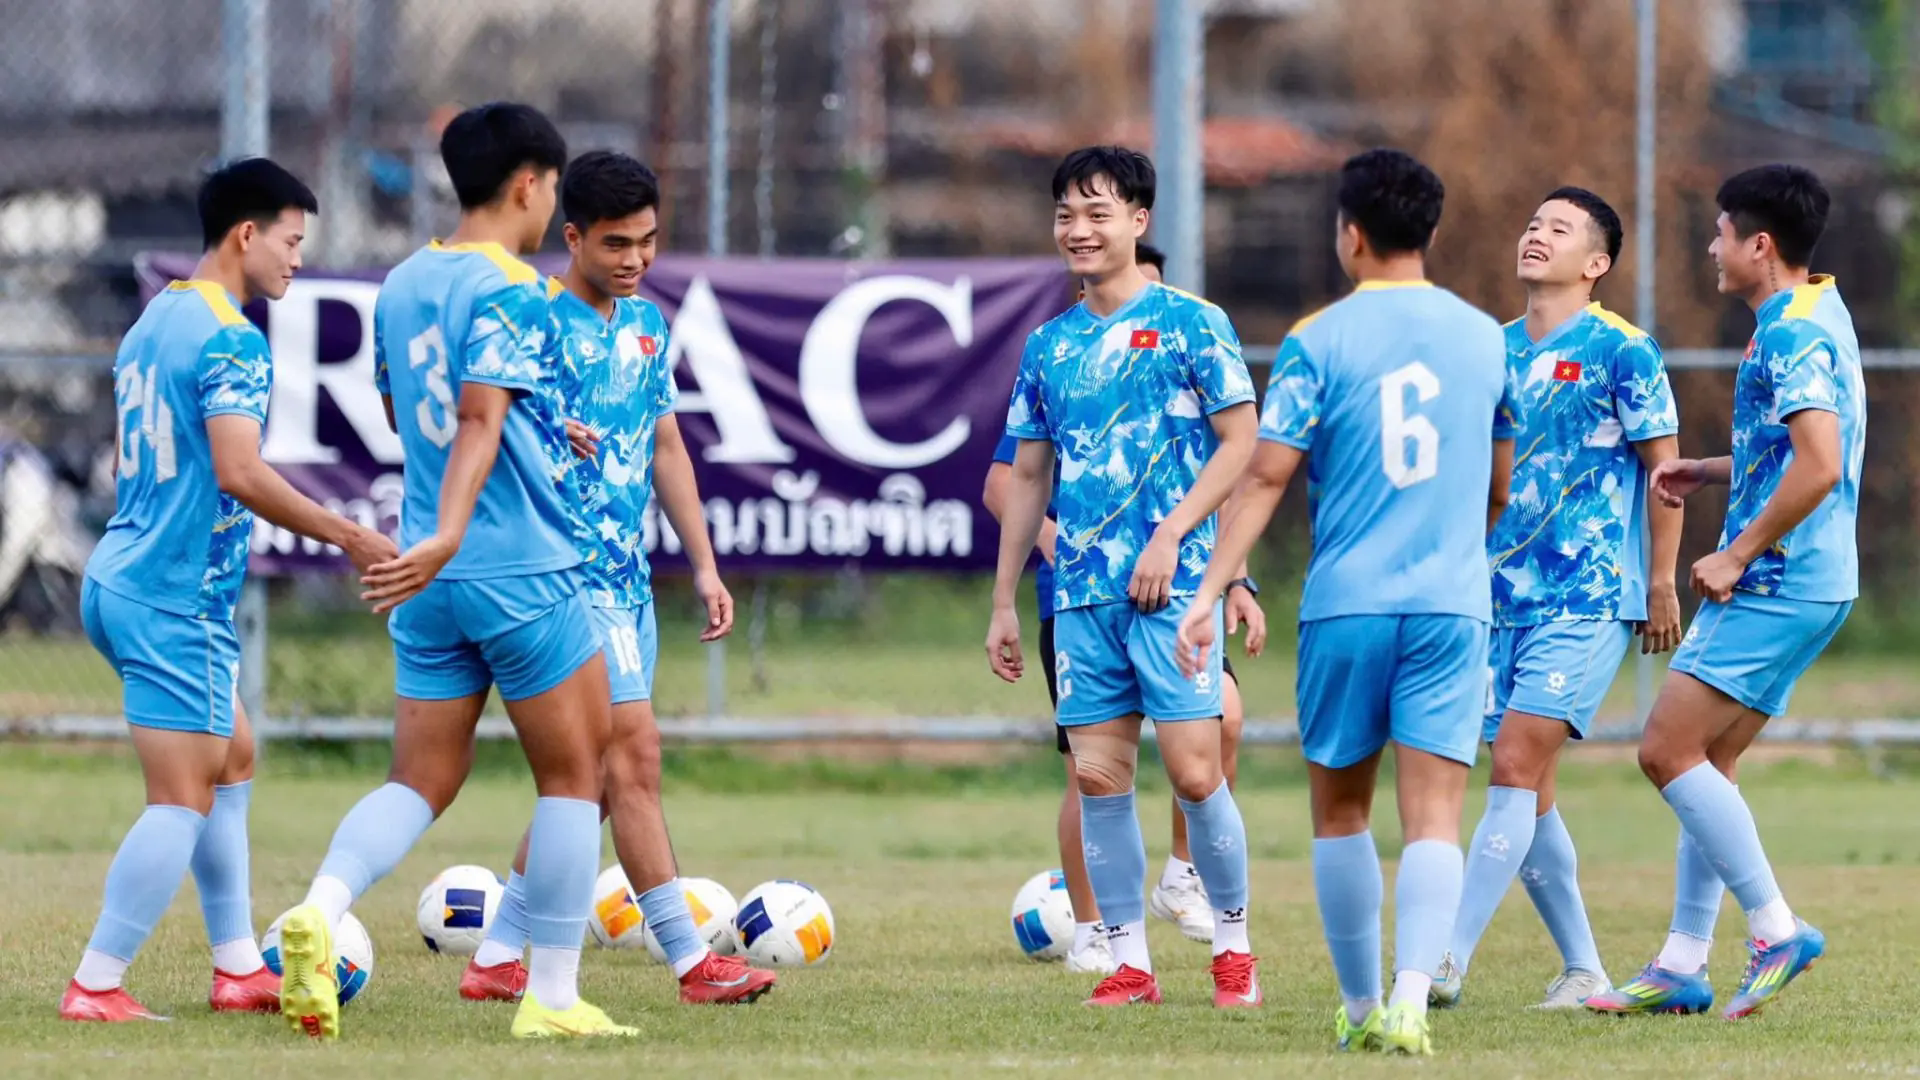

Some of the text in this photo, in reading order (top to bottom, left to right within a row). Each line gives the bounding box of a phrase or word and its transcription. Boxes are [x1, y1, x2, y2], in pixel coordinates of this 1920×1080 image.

[117, 360, 177, 484] 24
[408, 323, 459, 449] 3
[1380, 360, 1440, 490] 6
